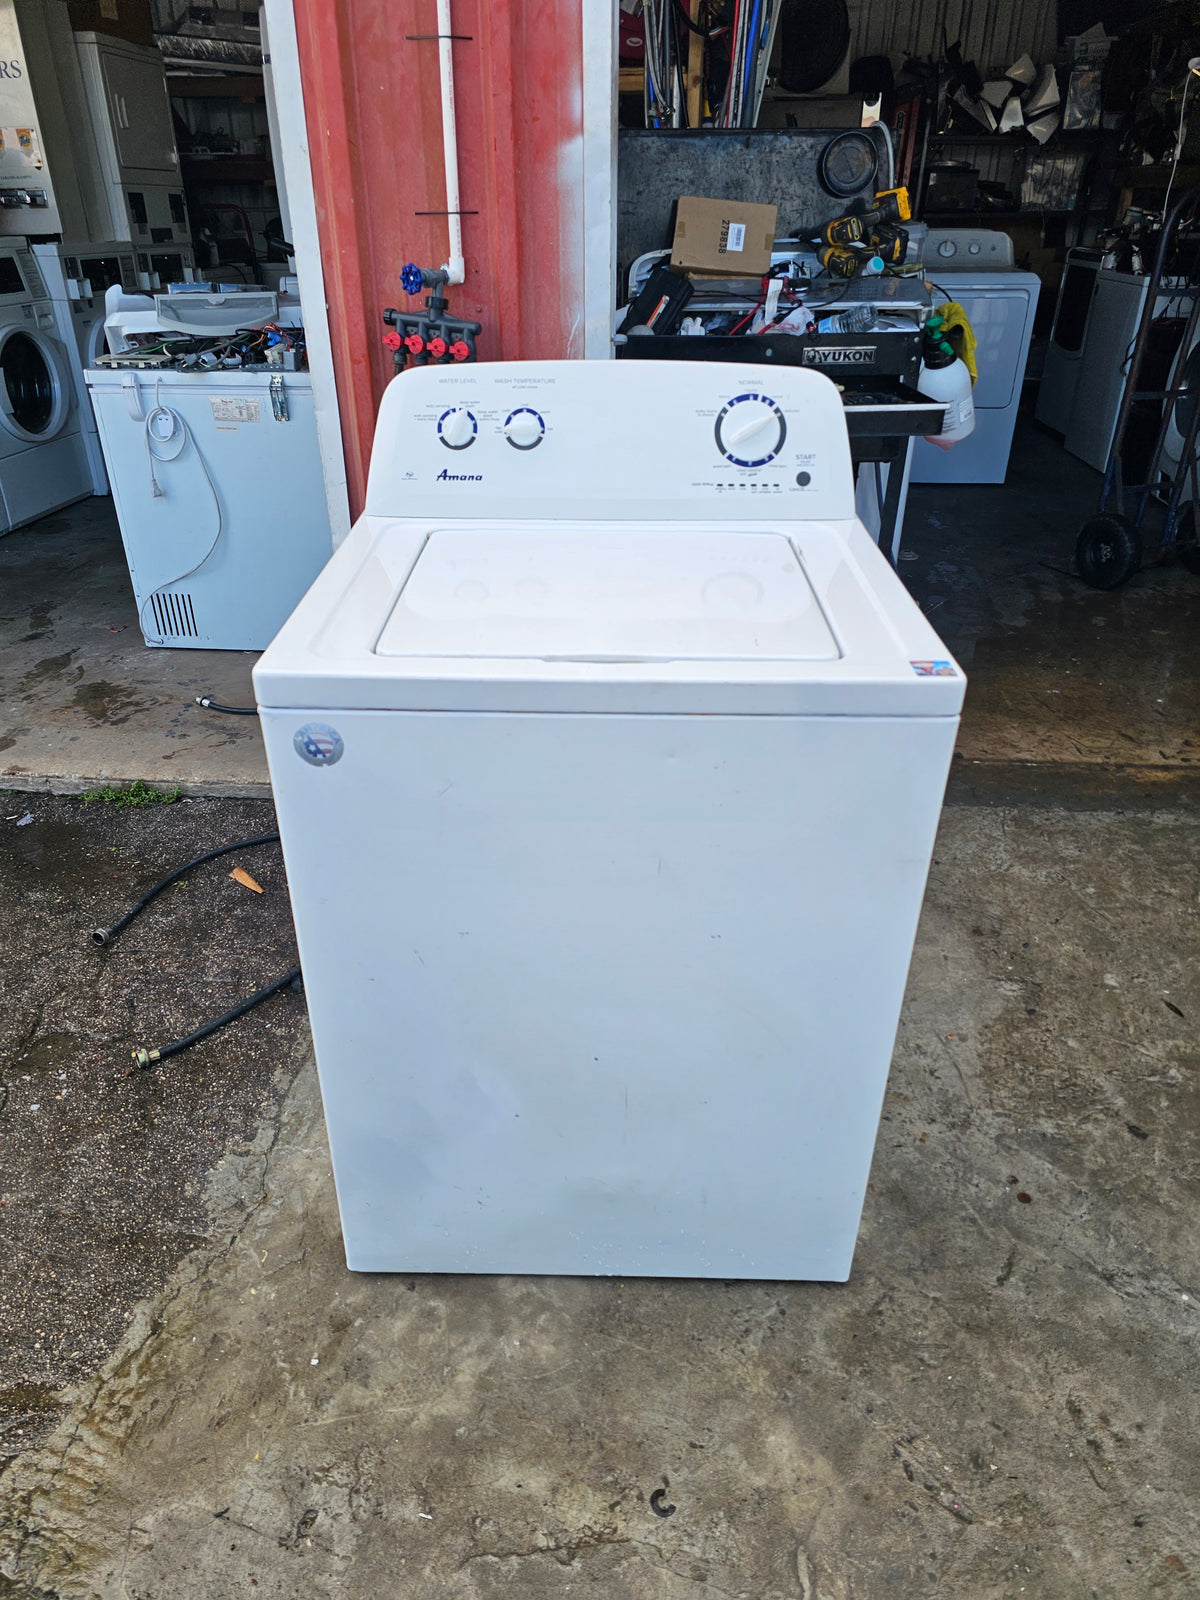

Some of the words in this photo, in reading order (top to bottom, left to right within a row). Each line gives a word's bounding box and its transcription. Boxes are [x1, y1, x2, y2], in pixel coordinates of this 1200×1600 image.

[718, 219, 731, 254] 279838
[822, 350, 874, 362] YUKON
[436, 468, 483, 482] Amana
